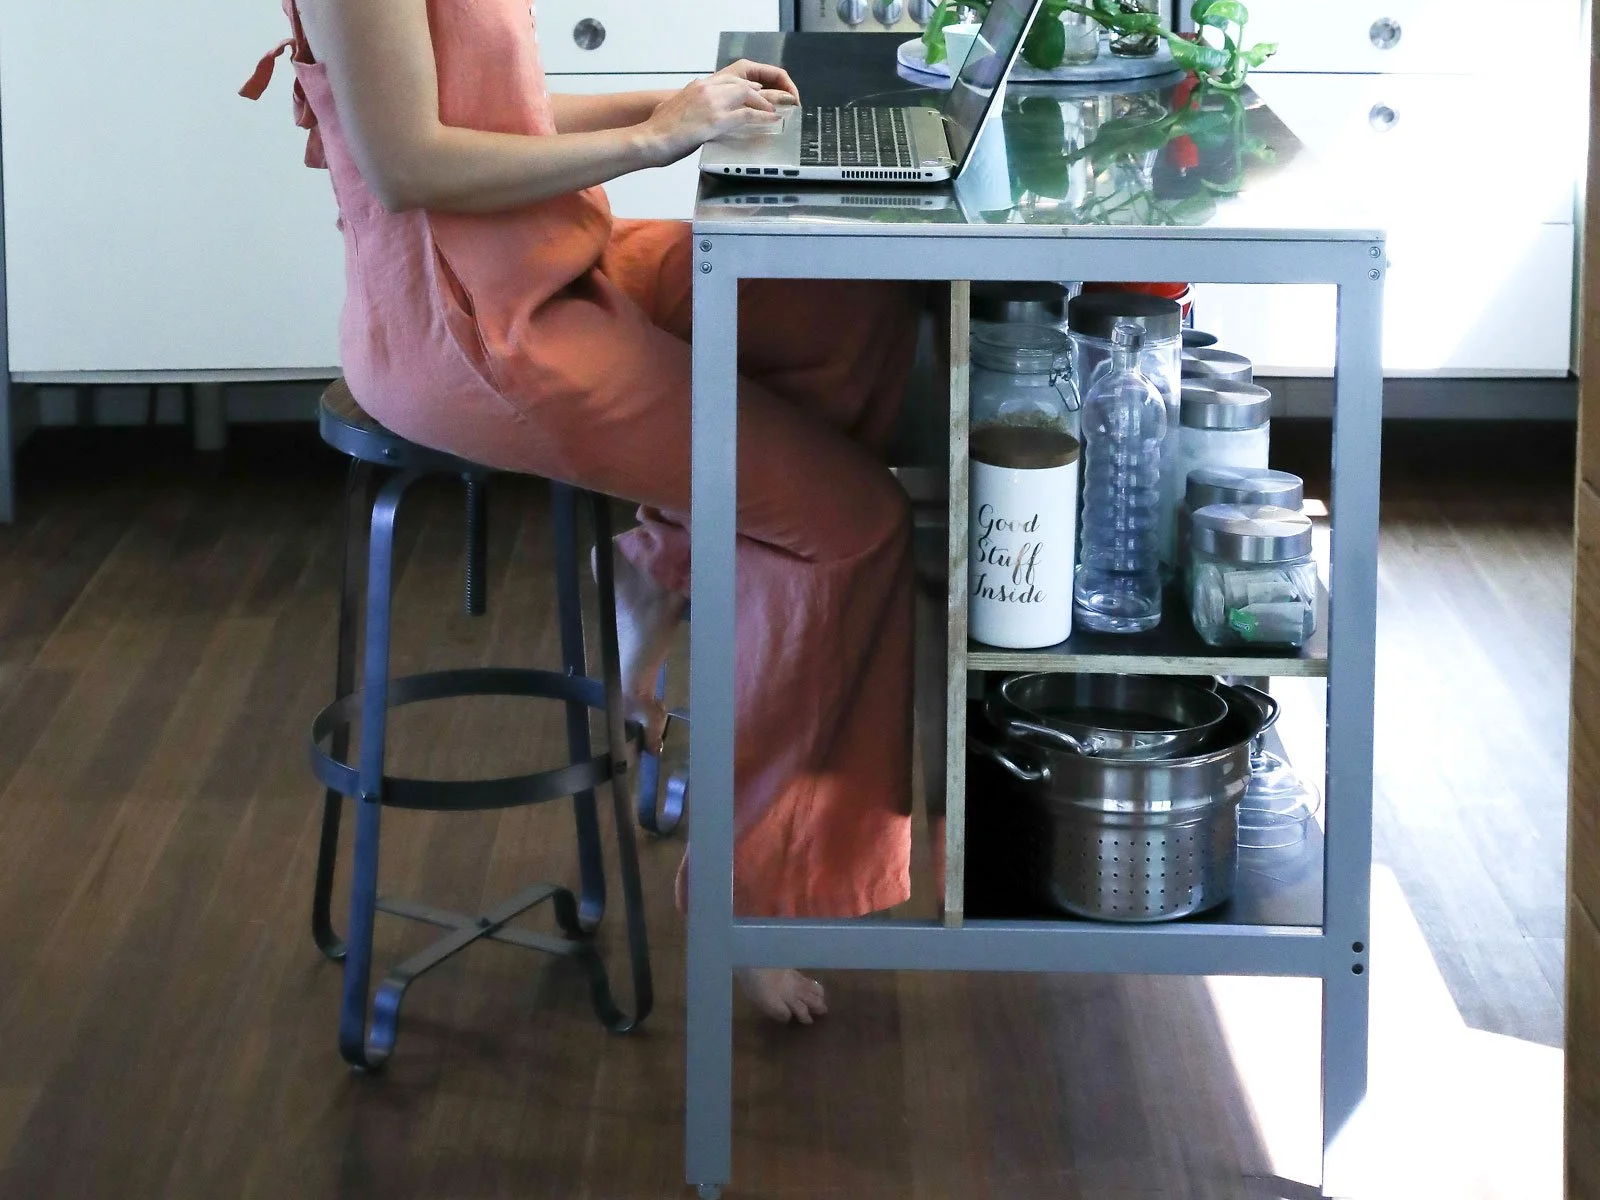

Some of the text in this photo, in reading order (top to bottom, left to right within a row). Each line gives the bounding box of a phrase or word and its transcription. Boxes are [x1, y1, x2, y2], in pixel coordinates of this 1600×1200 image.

[978, 503, 1040, 538] Good
[975, 536, 1044, 586] Stuff
[971, 572, 1047, 604] Inside
